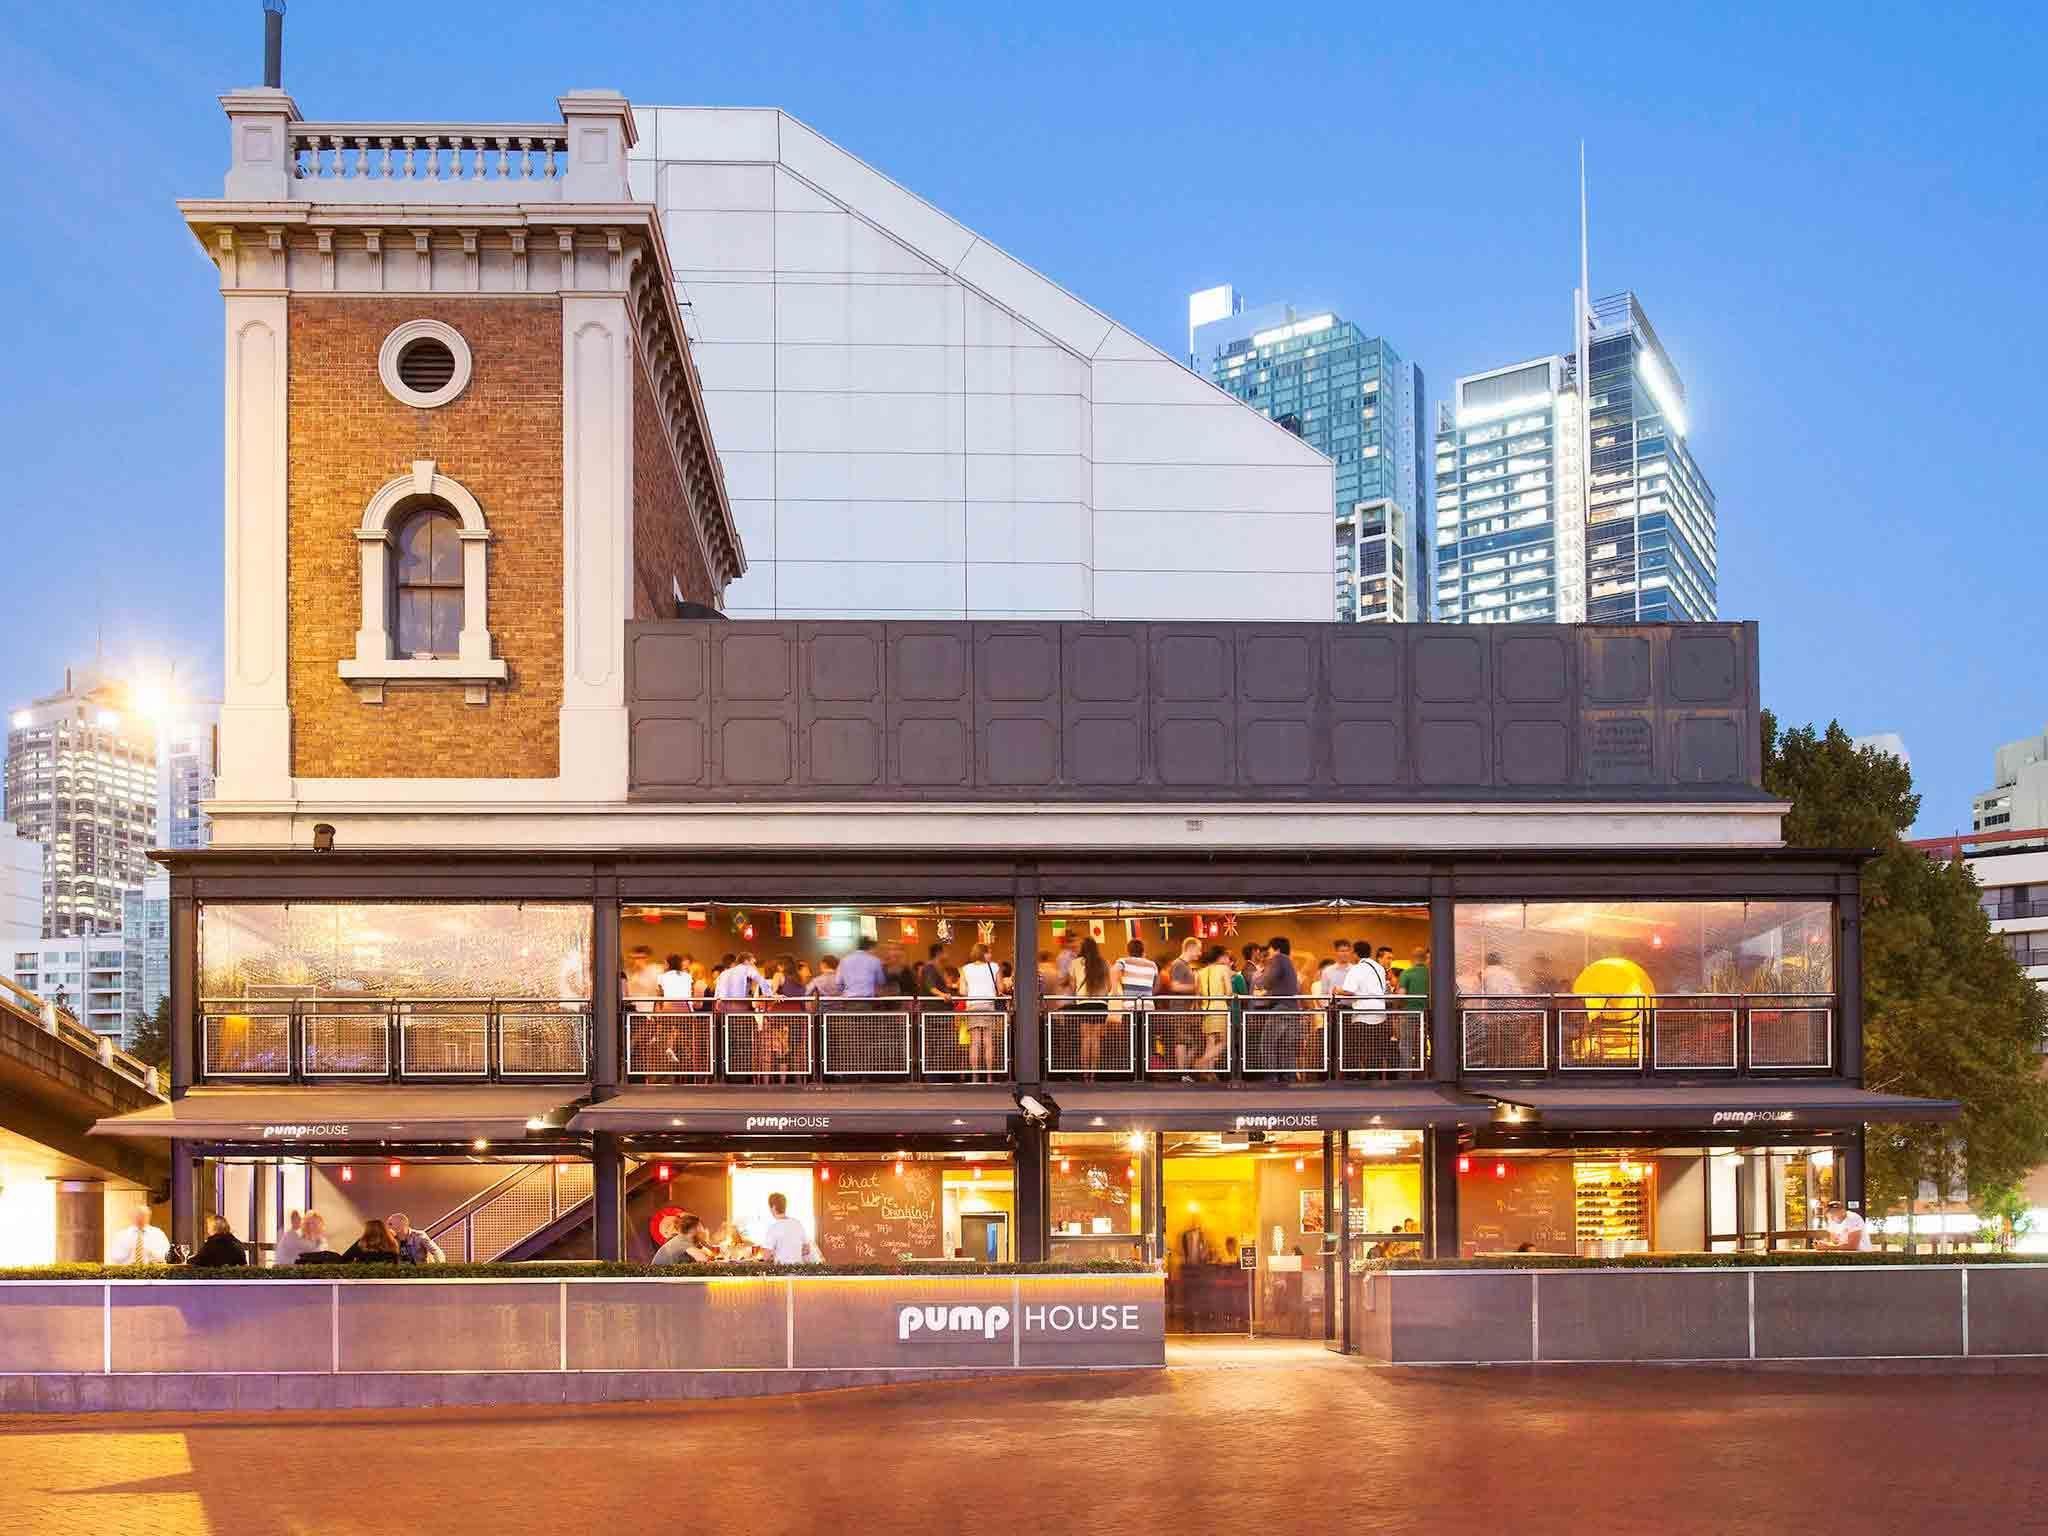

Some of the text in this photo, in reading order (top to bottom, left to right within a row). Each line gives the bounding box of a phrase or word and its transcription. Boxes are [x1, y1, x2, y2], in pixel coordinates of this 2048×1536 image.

[746, 1116, 830, 1130] pumpHOUSE
[1235, 1115, 1318, 1130] pumpHOUSE
[263, 1124, 349, 1138] pumpHOUSE
[839, 1172, 880, 1188] What
[899, 1305, 1140, 1339] pump HOUSE
